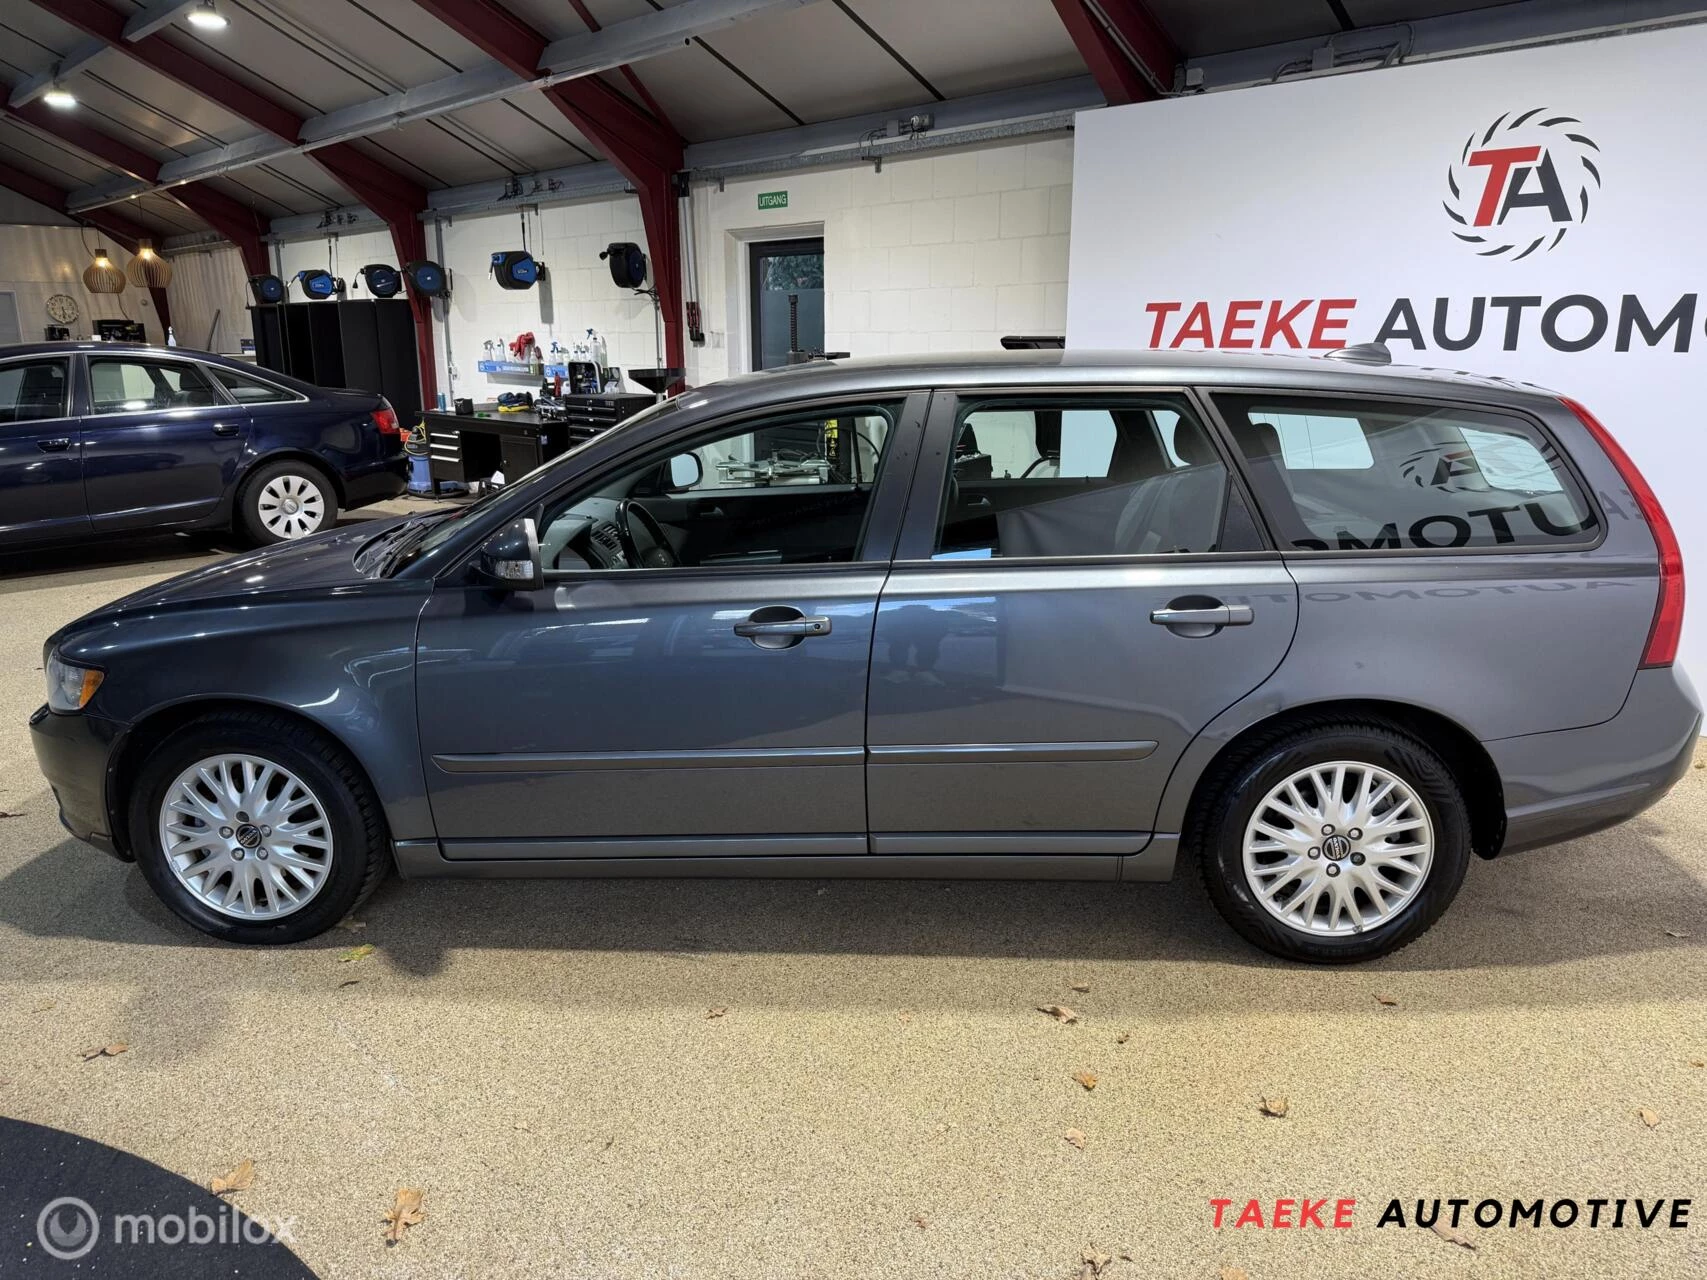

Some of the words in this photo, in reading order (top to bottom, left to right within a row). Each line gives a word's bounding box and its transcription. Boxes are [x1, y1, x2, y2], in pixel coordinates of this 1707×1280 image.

[759, 194, 787, 207] UITGANG
[1468, 145, 1573, 227] TA
[1145, 298, 1357, 350] TAEKE
[1373, 293, 1707, 353] AUTOM
